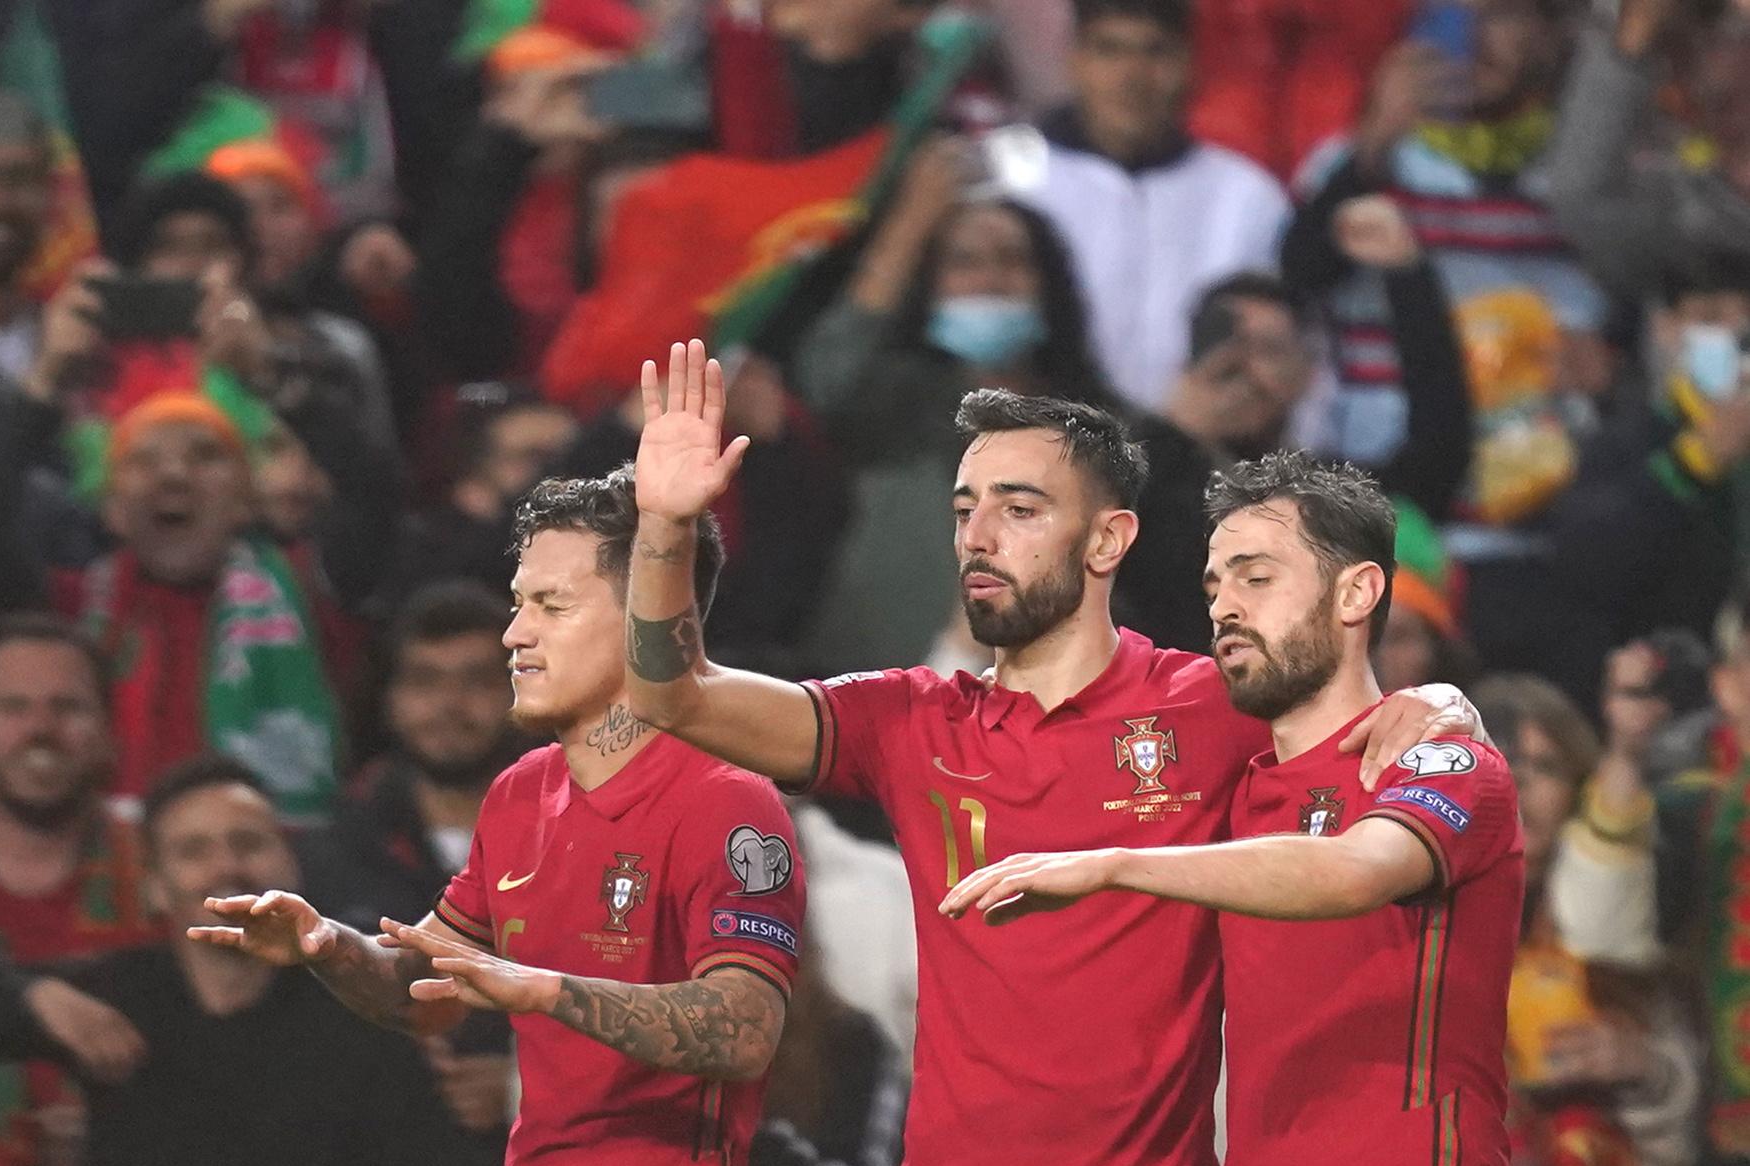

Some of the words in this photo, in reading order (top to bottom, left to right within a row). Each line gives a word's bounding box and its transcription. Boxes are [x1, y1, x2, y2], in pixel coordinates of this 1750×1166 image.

[1403, 788, 1469, 827] RESPECT
[928, 788, 987, 888] 11
[739, 918, 797, 950] RESPECT
